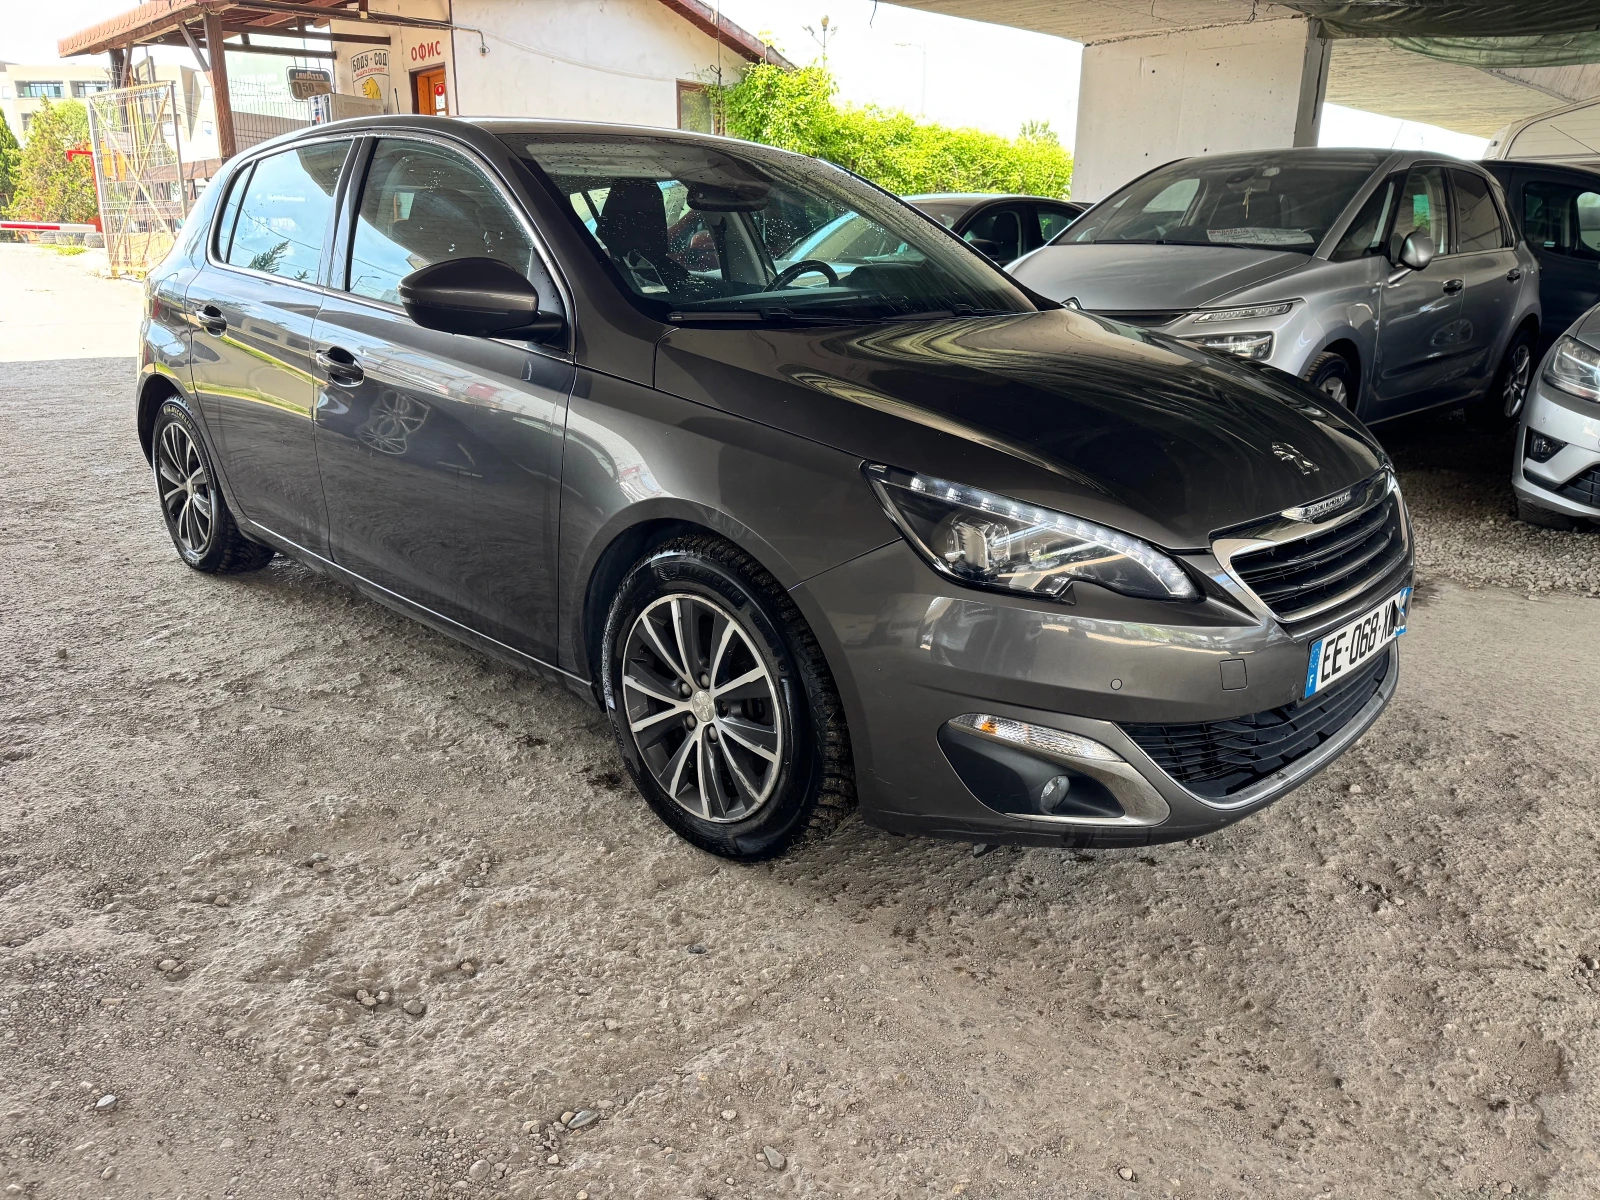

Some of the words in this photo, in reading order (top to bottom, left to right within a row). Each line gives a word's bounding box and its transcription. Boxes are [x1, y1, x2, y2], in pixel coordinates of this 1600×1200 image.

[411, 40, 441, 61] ОФИС
[374, 52, 387, 66] СОД
[1309, 674, 1315, 688] F
